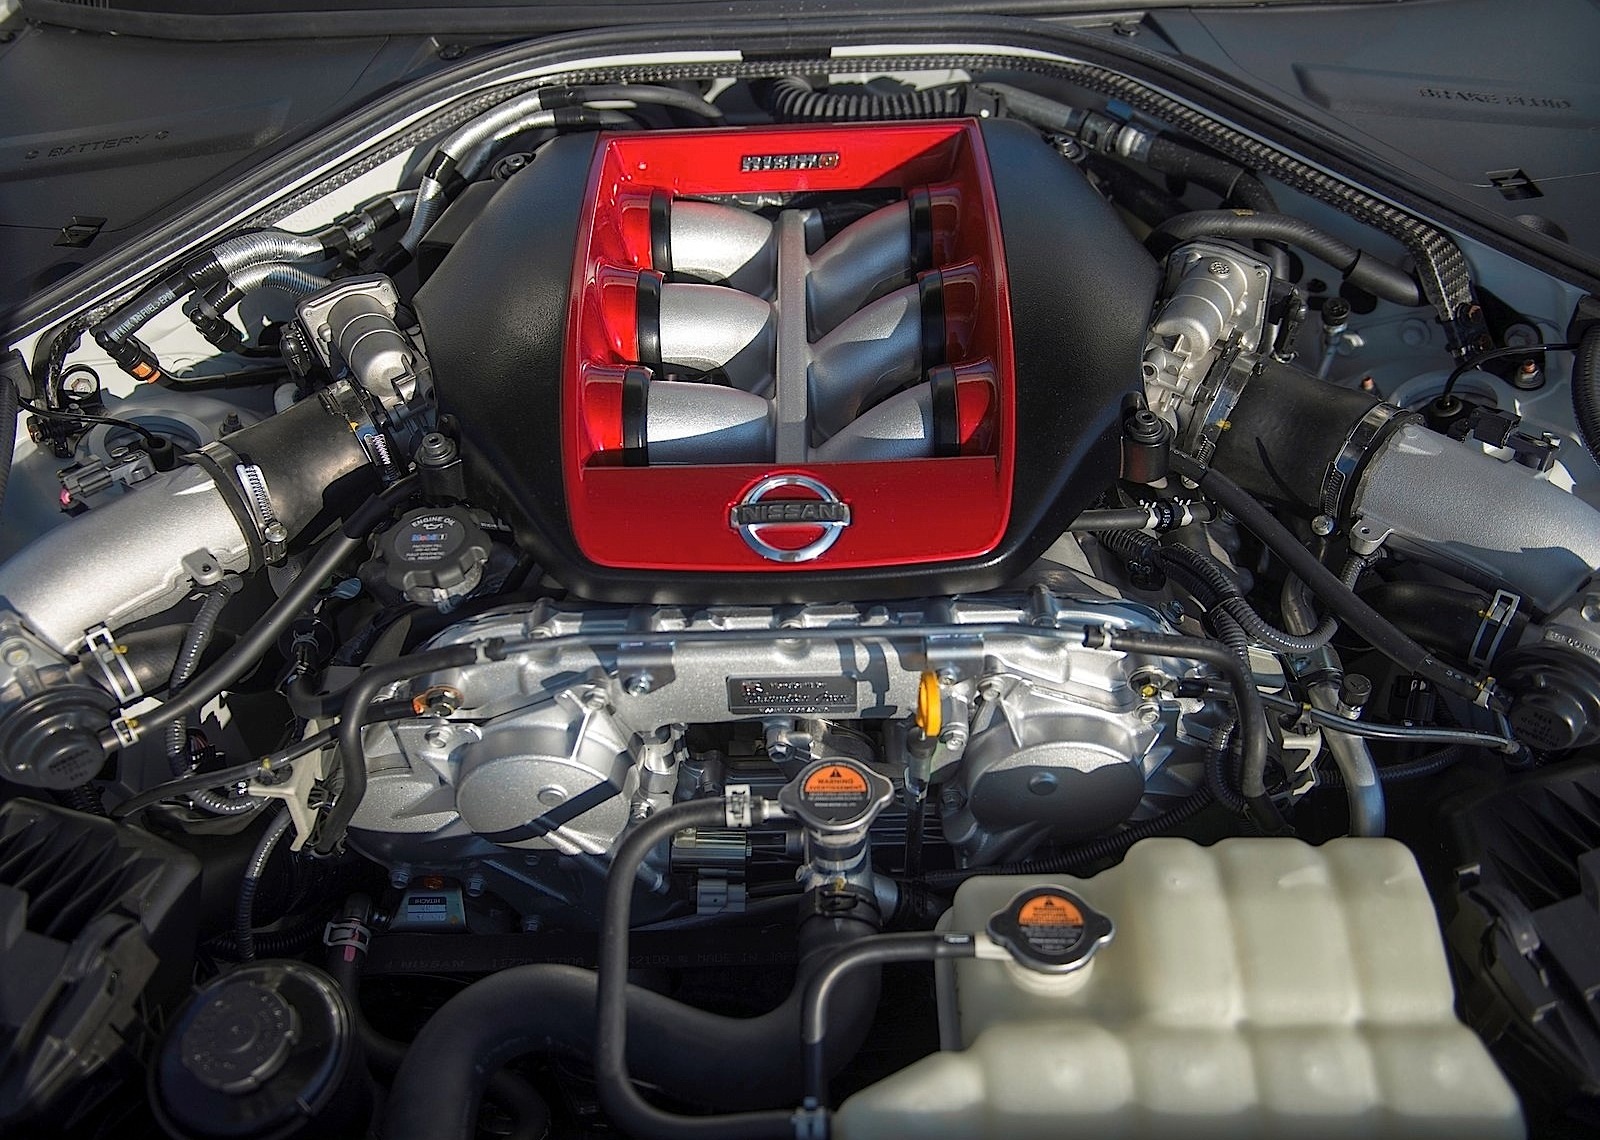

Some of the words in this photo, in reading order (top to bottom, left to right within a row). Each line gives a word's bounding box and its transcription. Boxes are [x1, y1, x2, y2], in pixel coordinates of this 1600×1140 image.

[1417, 88, 1499, 104] BRAKE
[48, 133, 150, 158] BATTERY
[742, 504, 837, 521] NISSAN
[411, 516, 443, 527] ENGINE
[443, 518, 456, 526] OIL
